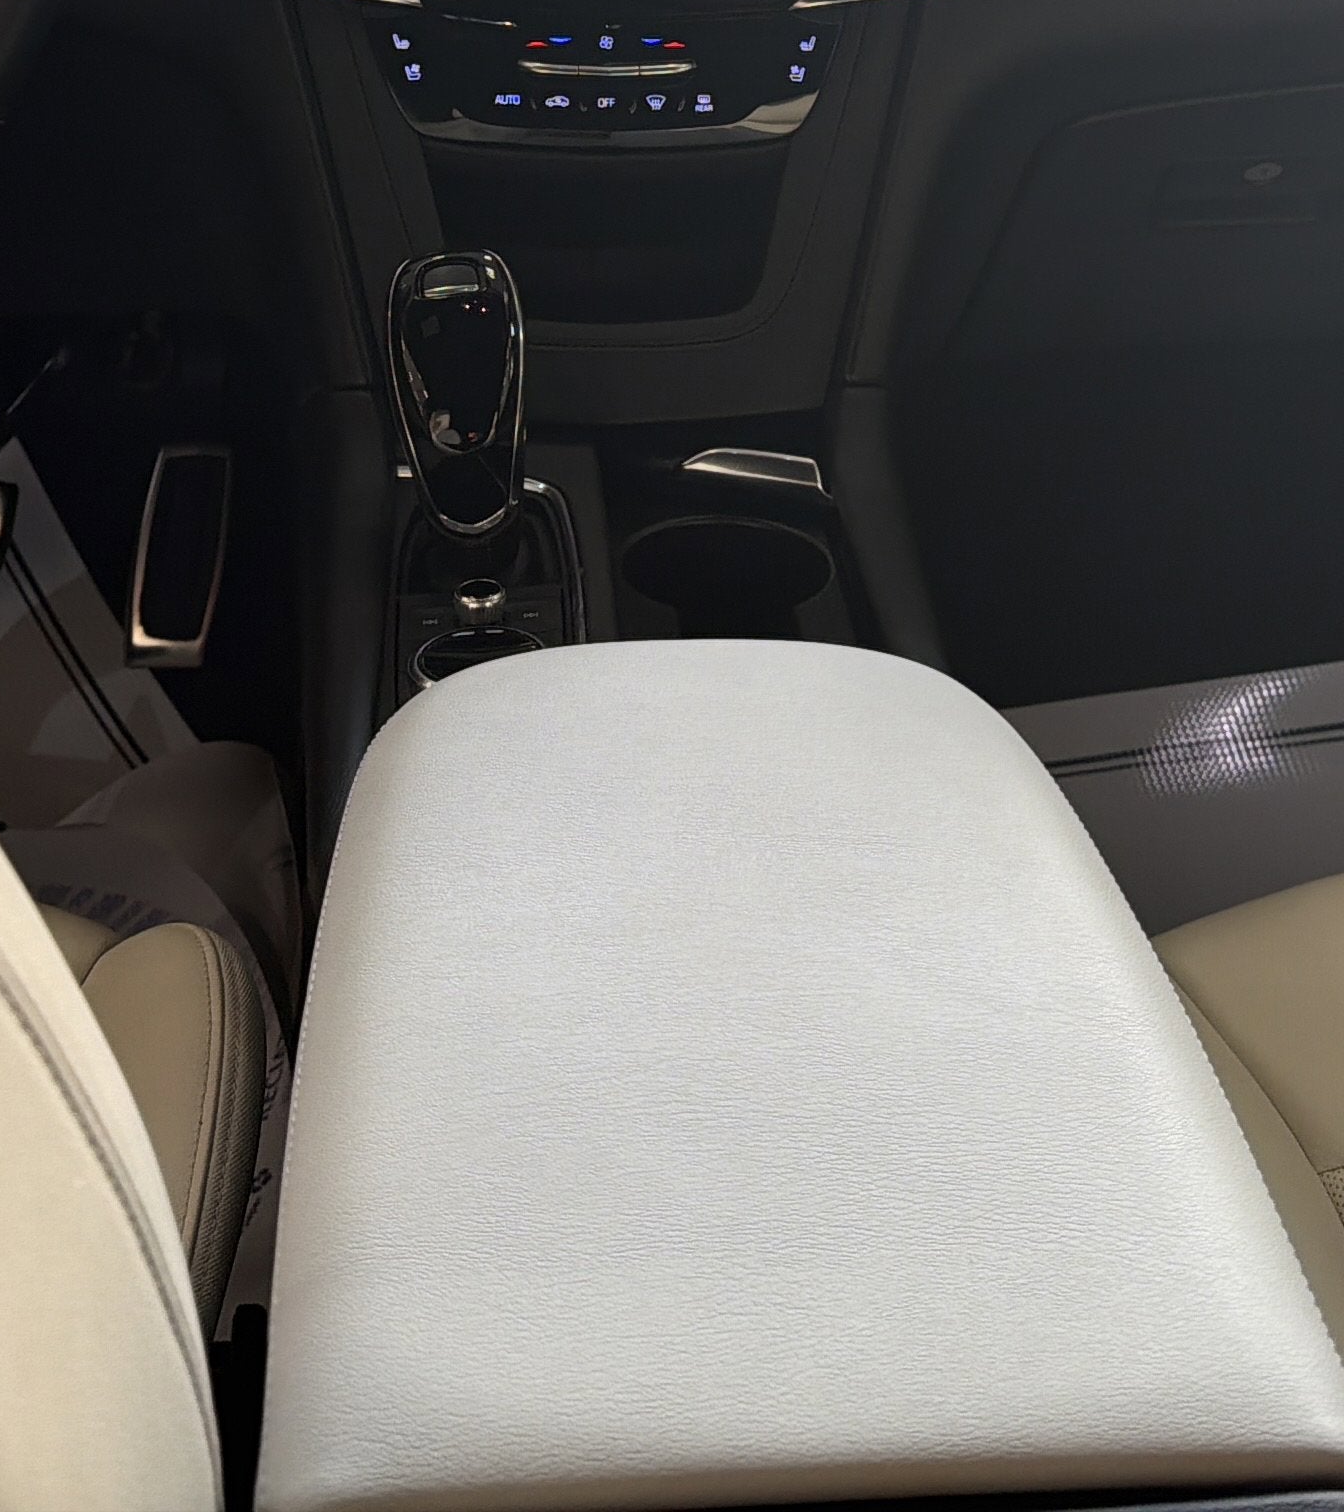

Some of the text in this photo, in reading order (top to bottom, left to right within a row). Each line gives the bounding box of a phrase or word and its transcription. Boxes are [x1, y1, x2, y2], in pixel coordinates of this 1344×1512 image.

[494, 94, 713, 112] AUTO OFF REAR
